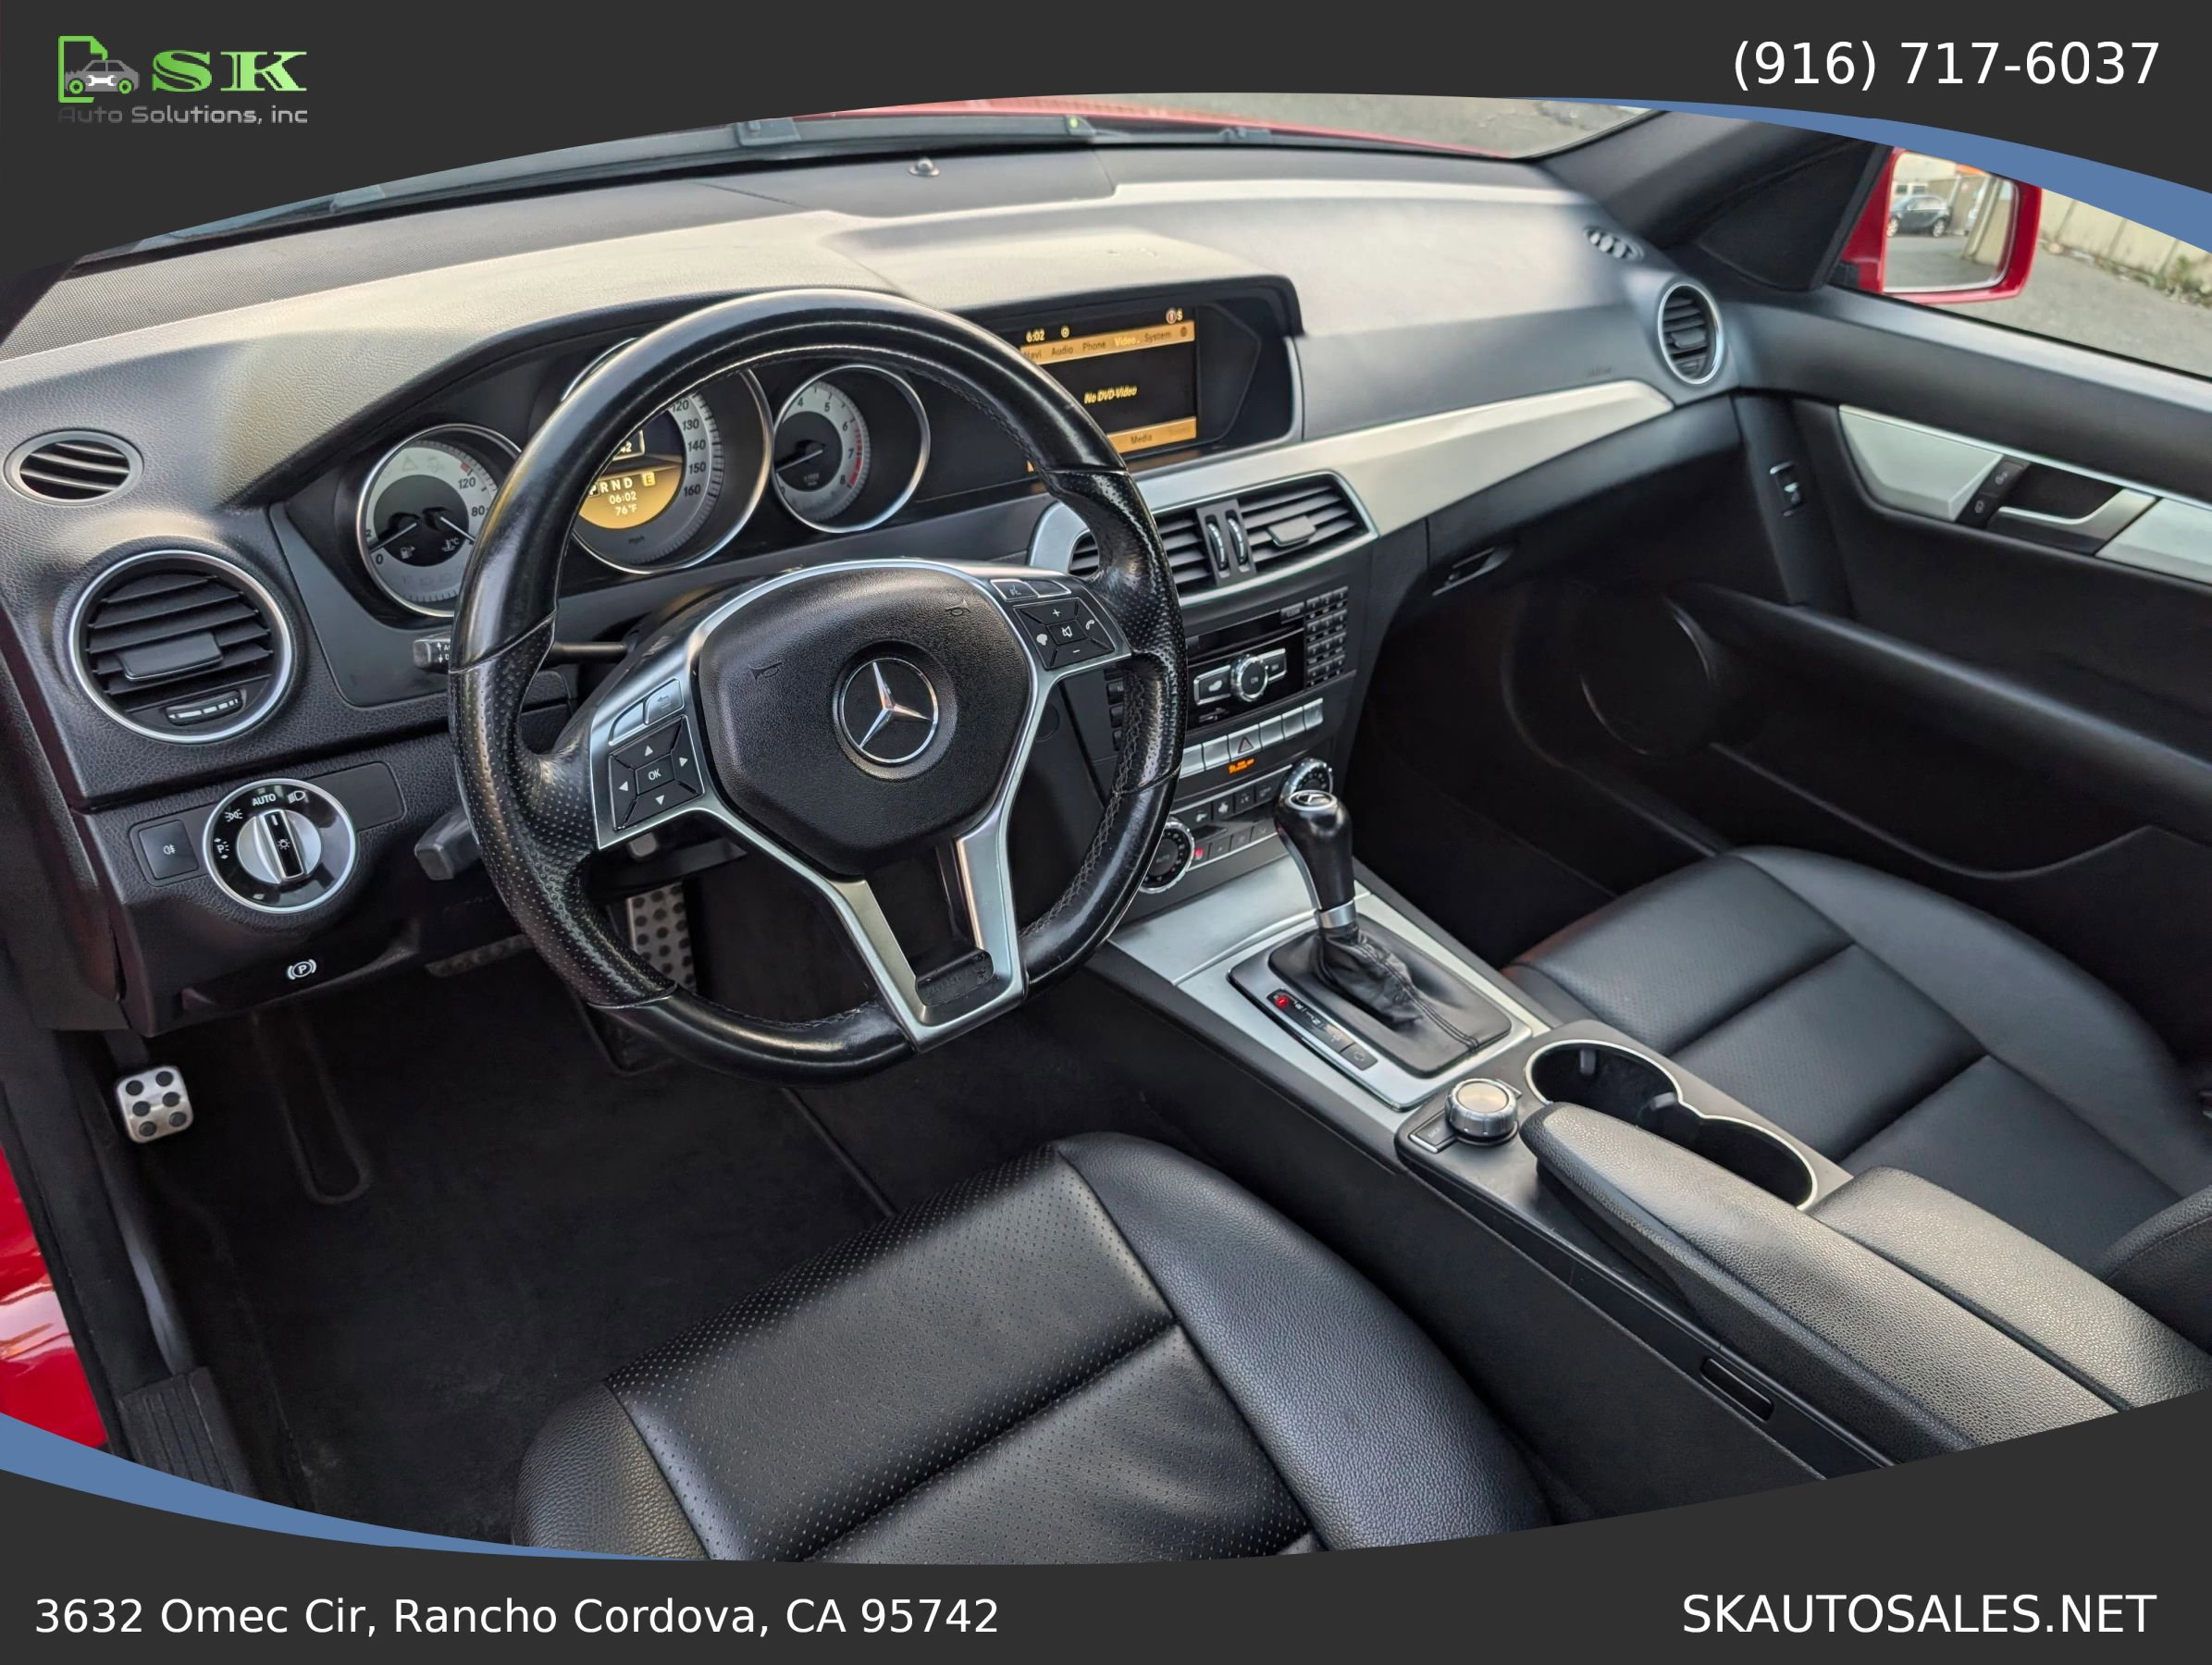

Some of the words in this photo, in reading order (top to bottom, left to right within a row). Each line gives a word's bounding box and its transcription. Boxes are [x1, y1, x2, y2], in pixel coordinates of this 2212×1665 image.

[1026, 328, 1045, 342] 6:02
[1052, 347, 1074, 356] Audio
[1082, 341, 1106, 352] Phone
[1114, 338, 1137, 347] Video
[1144, 330, 1172, 341] System
[797, 397, 804, 407] 4
[1083, 392, 1097, 404] No
[672, 400, 689, 412] 120
[824, 402, 831, 413] 5
[682, 418, 699, 431] 130
[842, 421, 848, 431] 6
[1131, 432, 1153, 444] Media
[687, 438, 707, 451] 140
[848, 448, 855, 459] 7
[688, 462, 707, 475] 150
[458, 476, 476, 489] 120
[840, 475, 846, 485] 8
[684, 485, 701, 497] 160
[609, 491, 637, 505] 06:02
[471, 505, 485, 516] 80
[376, 553, 383, 564] 0
[648, 769, 662, 781] OK
[251, 793, 277, 807] AUTO
